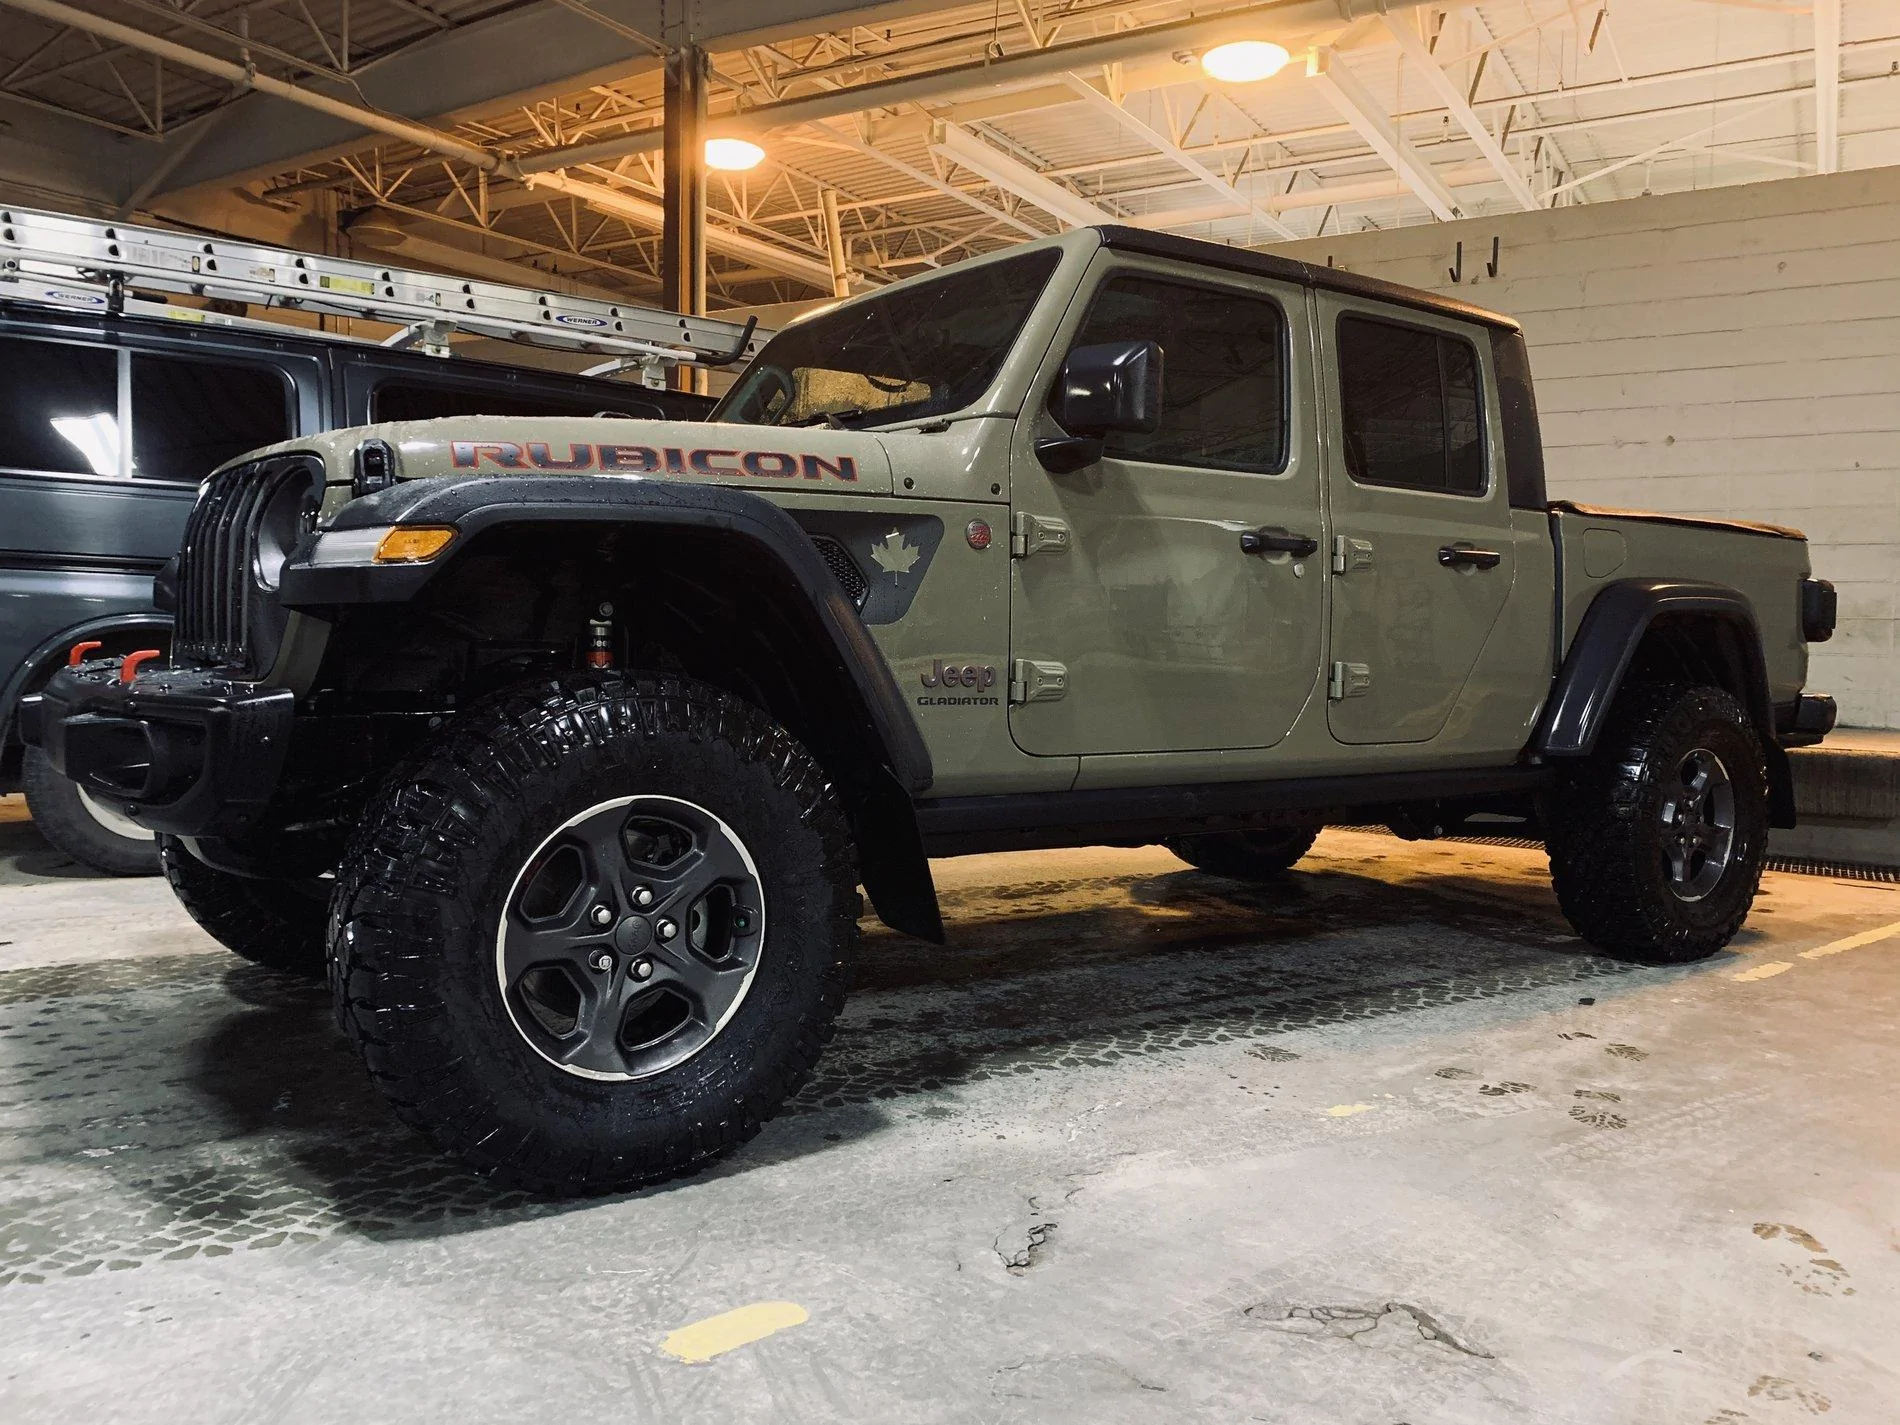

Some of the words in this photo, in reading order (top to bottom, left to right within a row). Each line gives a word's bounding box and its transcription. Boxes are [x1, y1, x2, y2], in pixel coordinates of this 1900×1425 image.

[566, 316, 598, 325] WERNER
[450, 440, 858, 482] RUBICON
[920, 659, 996, 693] Jeep
[917, 696, 999, 706] GLADIATOR
